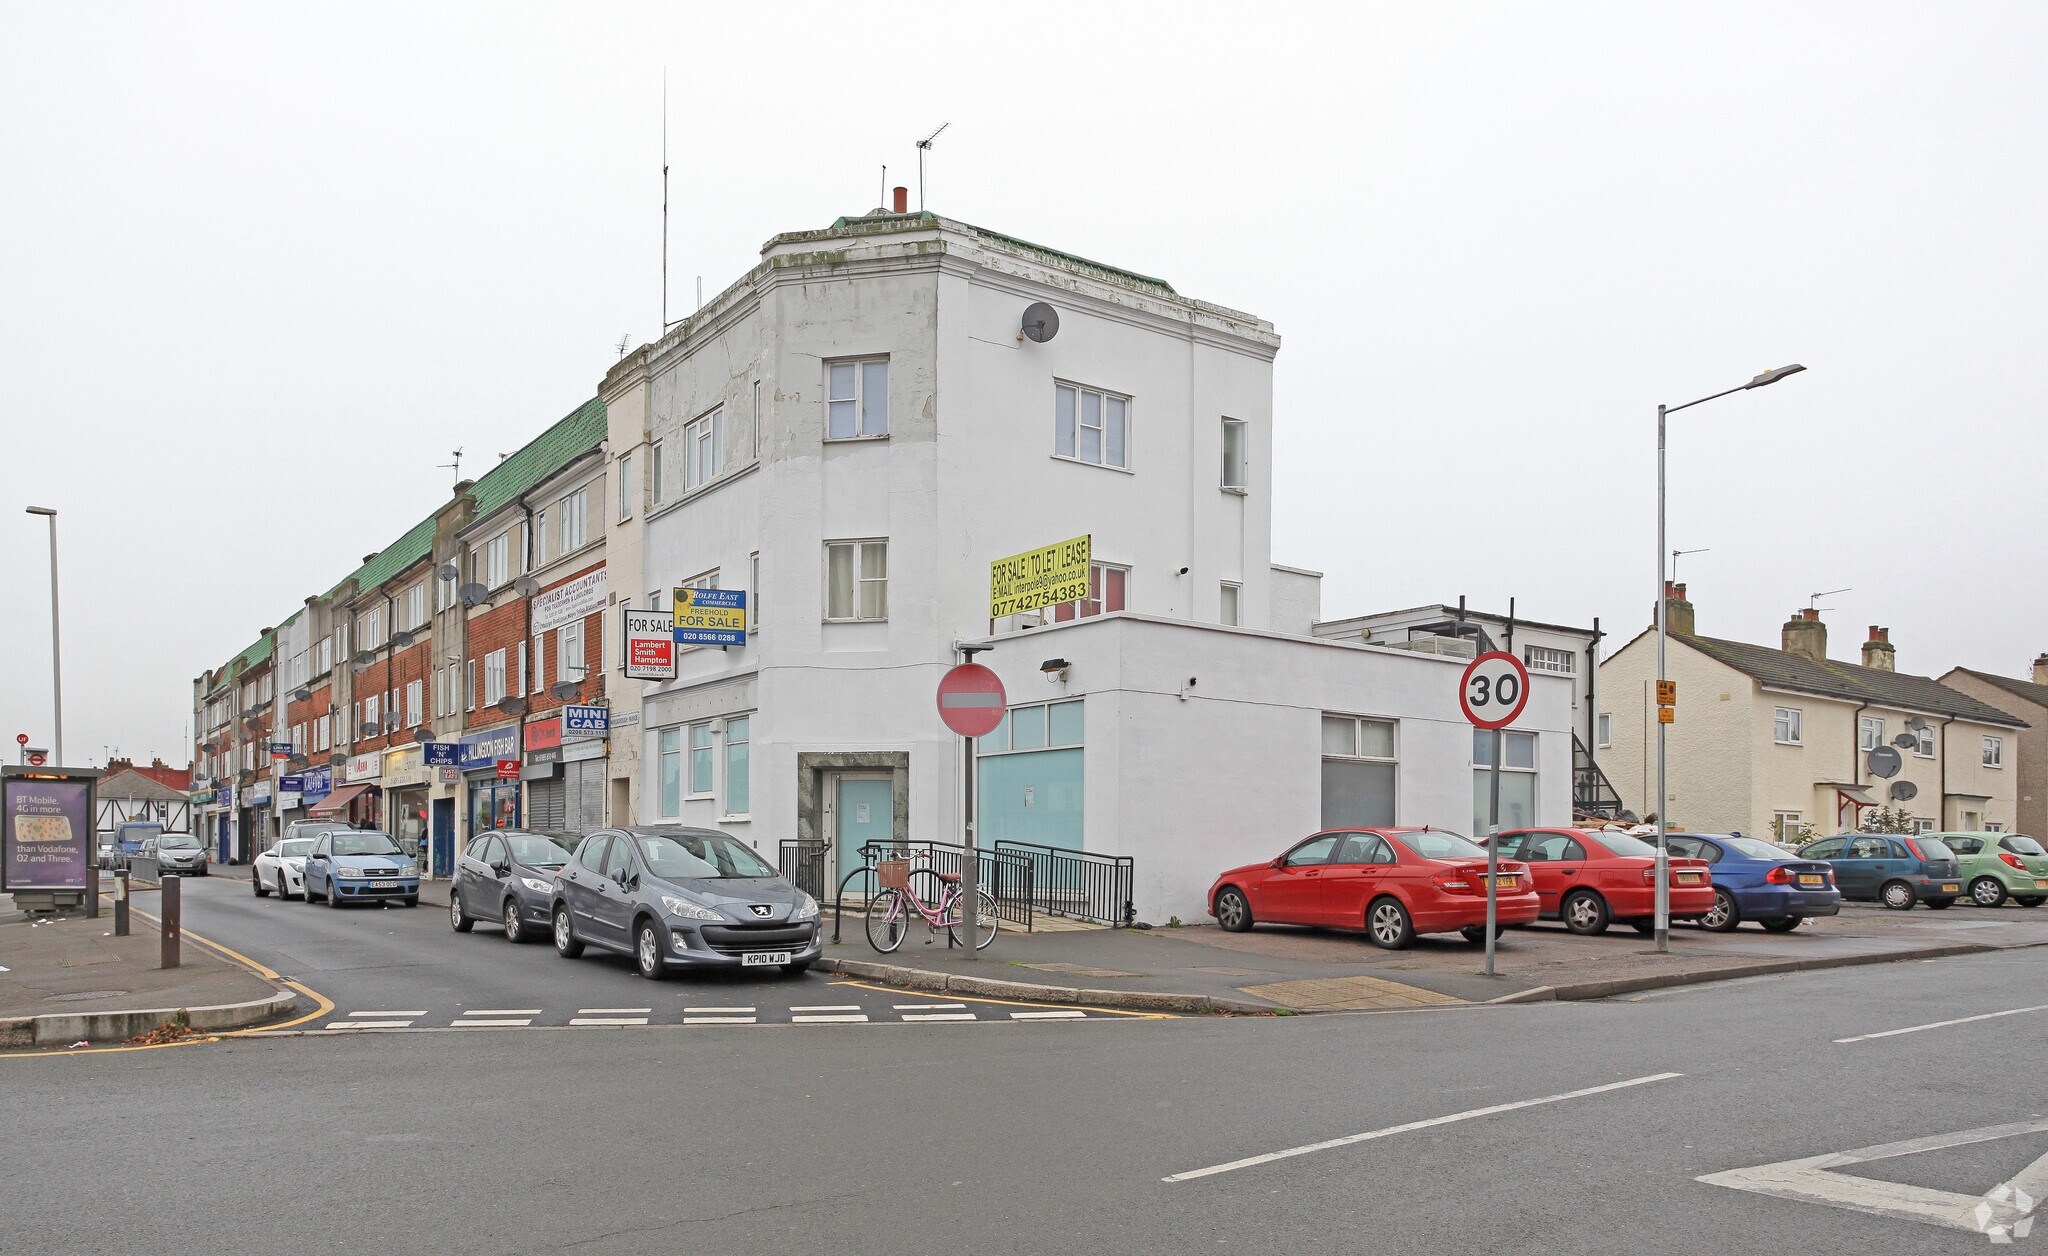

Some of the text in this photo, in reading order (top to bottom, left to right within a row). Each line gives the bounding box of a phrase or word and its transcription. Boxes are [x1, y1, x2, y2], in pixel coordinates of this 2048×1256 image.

[992, 564, 1006, 586] FOR
[1008, 558, 1026, 582] SALE
[1031, 554, 1040, 576] TO
[1042, 550, 1056, 573] LET
[1062, 540, 1086, 568] LEASE
[533, 588, 564, 610] SPECIALIST
[992, 582, 1086, 616] 07742754383
[629, 619, 673, 632] FOR SALE
[680, 616, 740, 628] FOR SALE
[635, 656, 667, 664] Hampton
[1470, 674, 1518, 706] 30
[568, 708, 607, 719] MINI
[570, 719, 606, 729] CAB
[468, 736, 514, 760] HILLINGDON FISH BAR
[29, 796, 60, 804] Mobile.
[38, 845, 78, 854] Vodafone,
[747, 954, 786, 963] KP10 WJD
